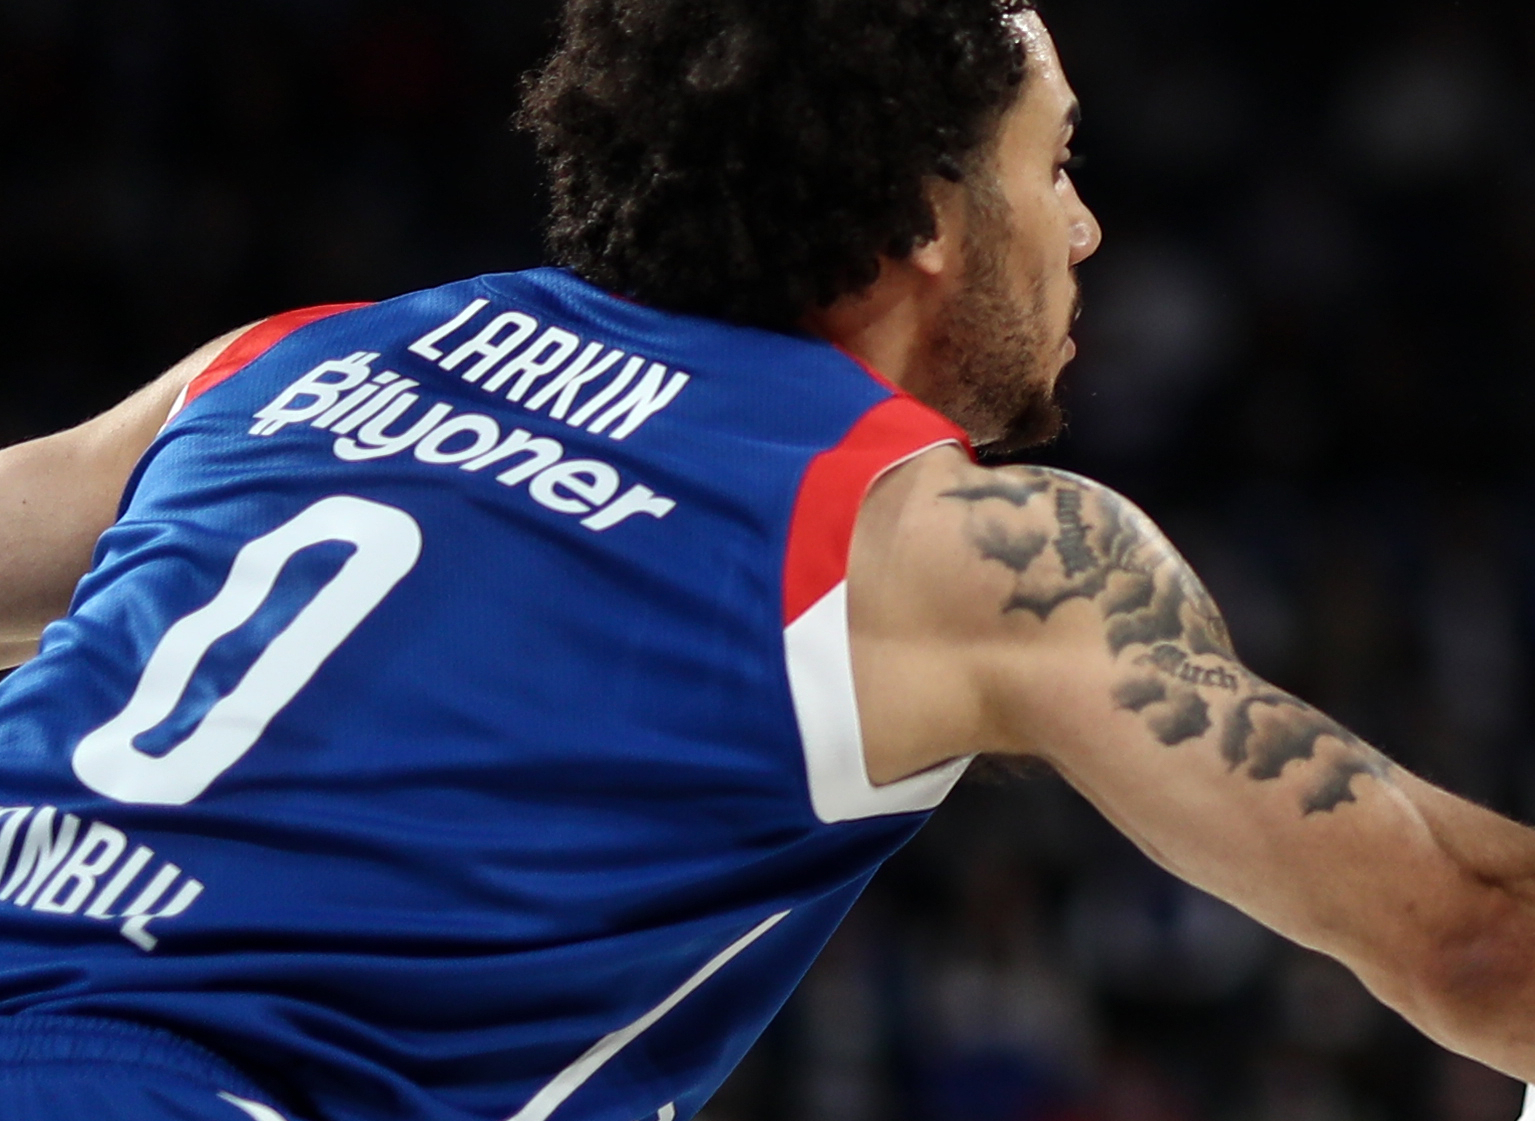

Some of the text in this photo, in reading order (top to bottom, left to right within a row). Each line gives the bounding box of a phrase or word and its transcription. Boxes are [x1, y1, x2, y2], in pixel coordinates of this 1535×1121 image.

[248, 350, 677, 531] Bilyoner
[408, 298, 690, 440] LARKIN
[72, 494, 423, 806] 0
